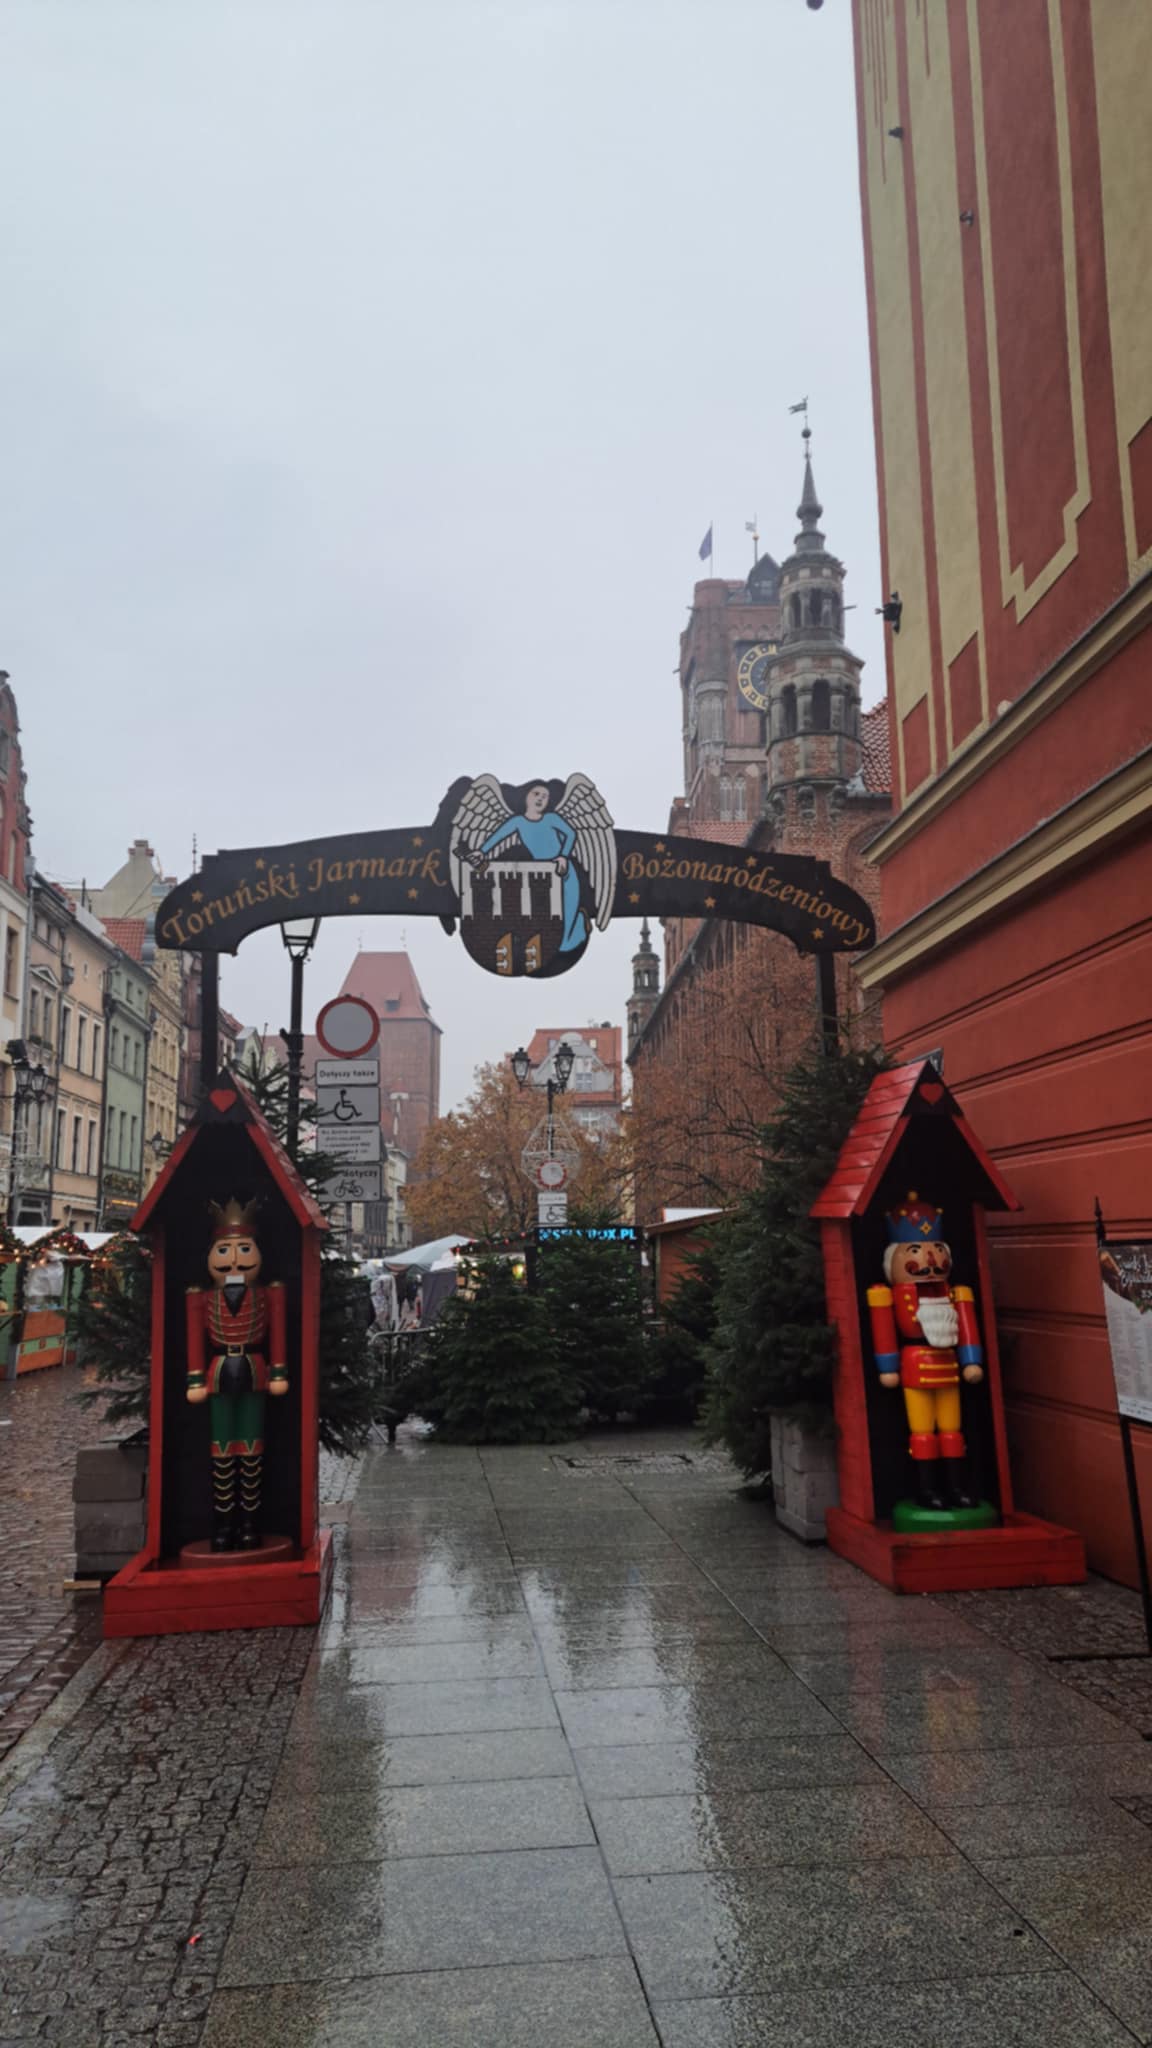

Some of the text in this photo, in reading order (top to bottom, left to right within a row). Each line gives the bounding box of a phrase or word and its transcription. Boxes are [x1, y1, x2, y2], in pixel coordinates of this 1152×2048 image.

[162, 849, 870, 946] Toruński Jarmark Bożonarodzeniowy
[319, 1070, 350, 1079] Dotyczy
